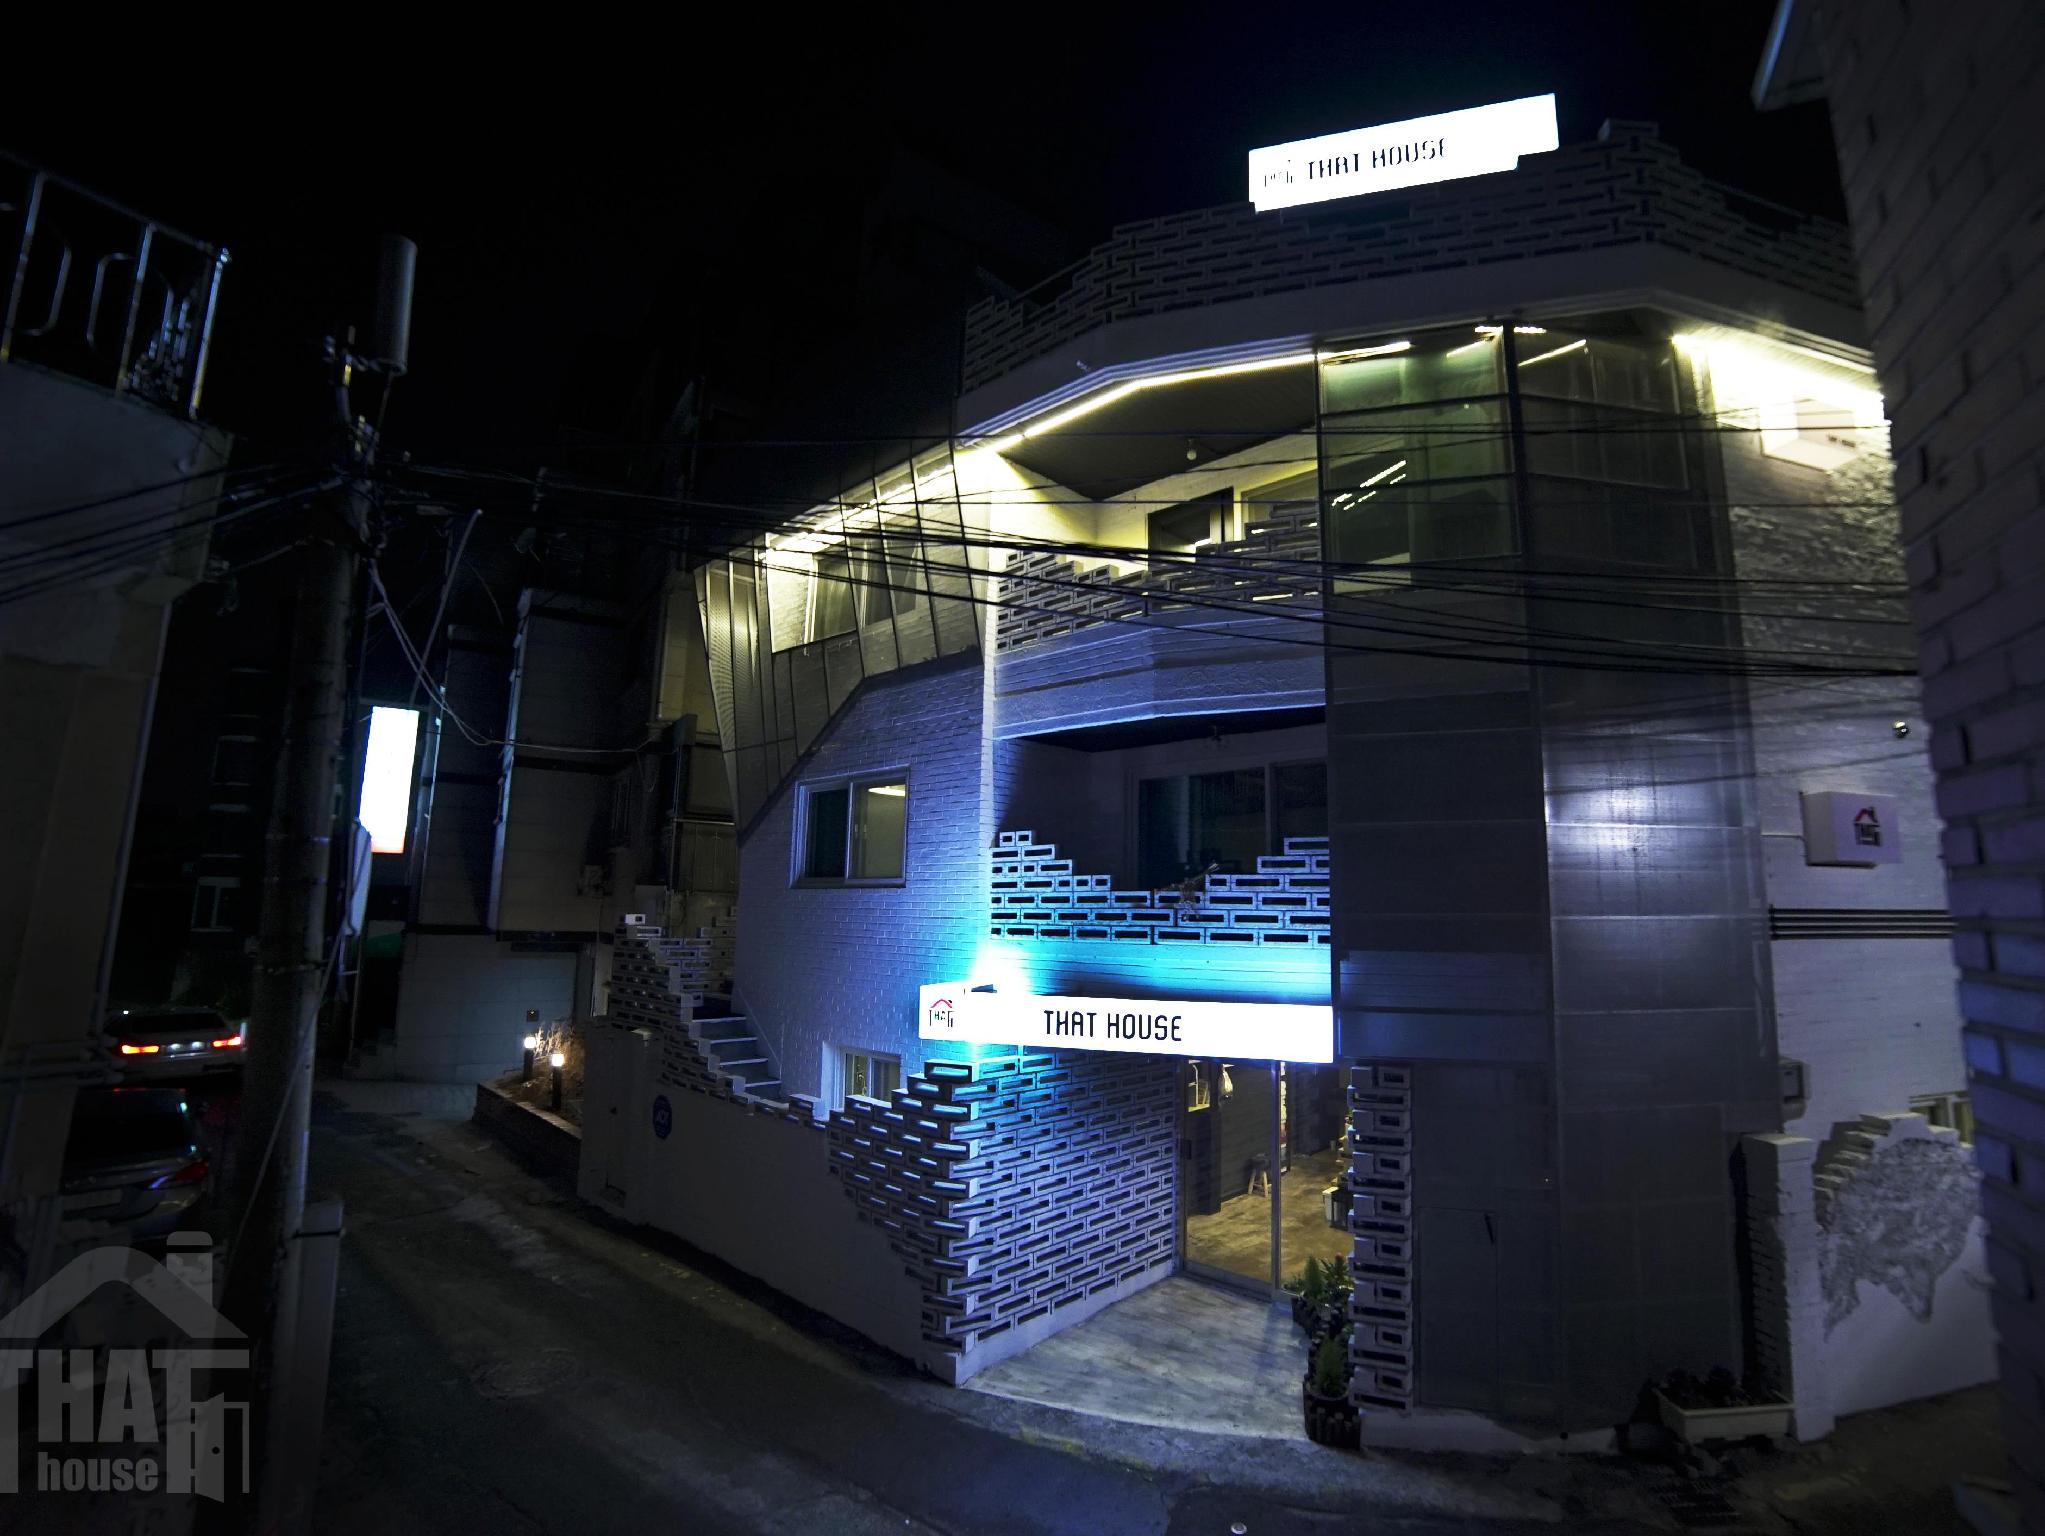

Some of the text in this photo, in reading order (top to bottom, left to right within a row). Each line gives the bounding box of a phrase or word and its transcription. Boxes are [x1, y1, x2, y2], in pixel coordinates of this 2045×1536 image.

[1308, 152, 1360, 180] THAT
[1043, 1010, 1182, 1042] THAT HOUSE
